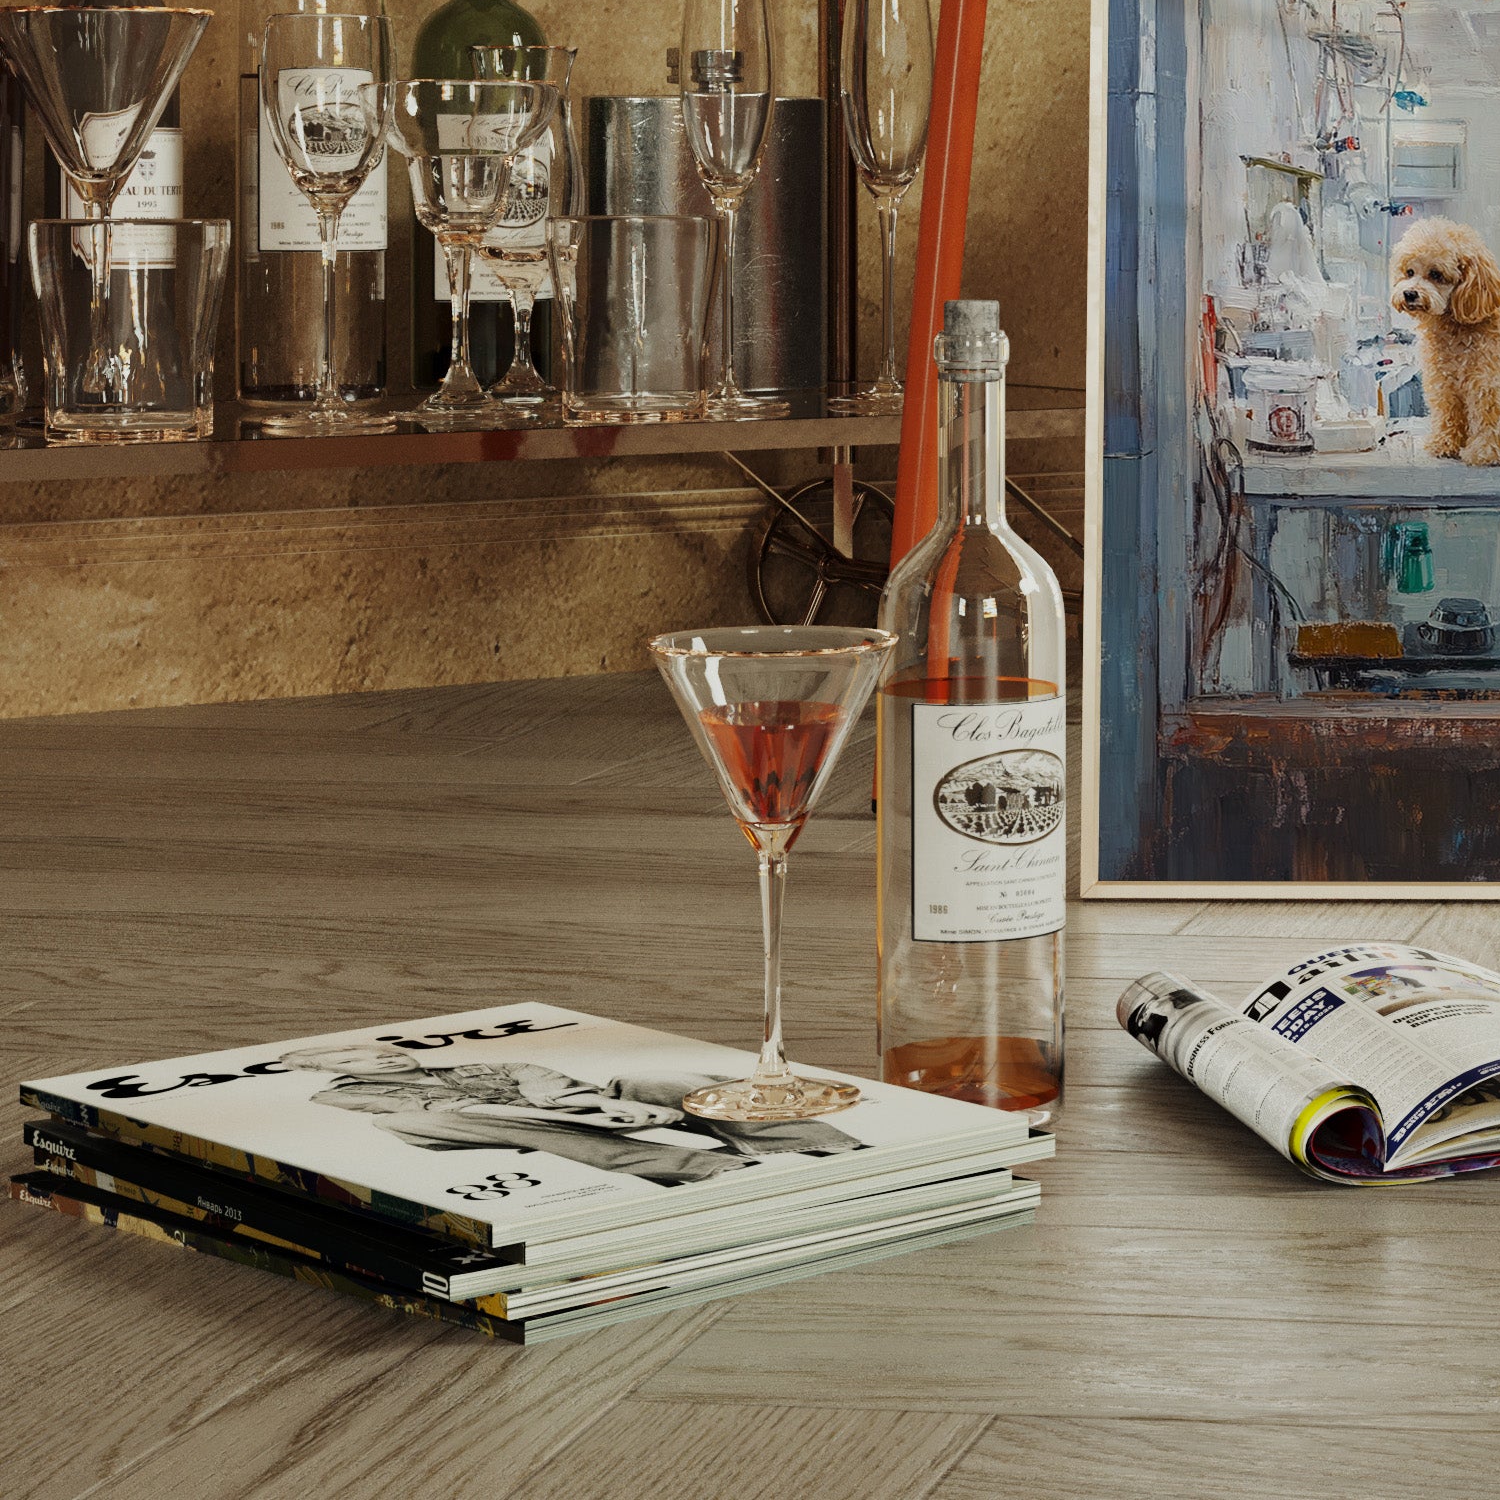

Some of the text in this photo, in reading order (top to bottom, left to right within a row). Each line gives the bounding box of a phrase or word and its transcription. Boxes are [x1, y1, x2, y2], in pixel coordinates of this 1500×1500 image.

[937, 711, 992, 743] Clos
[928, 904, 949, 916] 1986
[32, 1130, 77, 1161] Esquire
[44, 1159, 75, 1178] Esquire
[19, 1189, 52, 1208] Esquire
[445, 1171, 542, 1201] 88
[197, 1195, 242, 1221] Январь 2013
